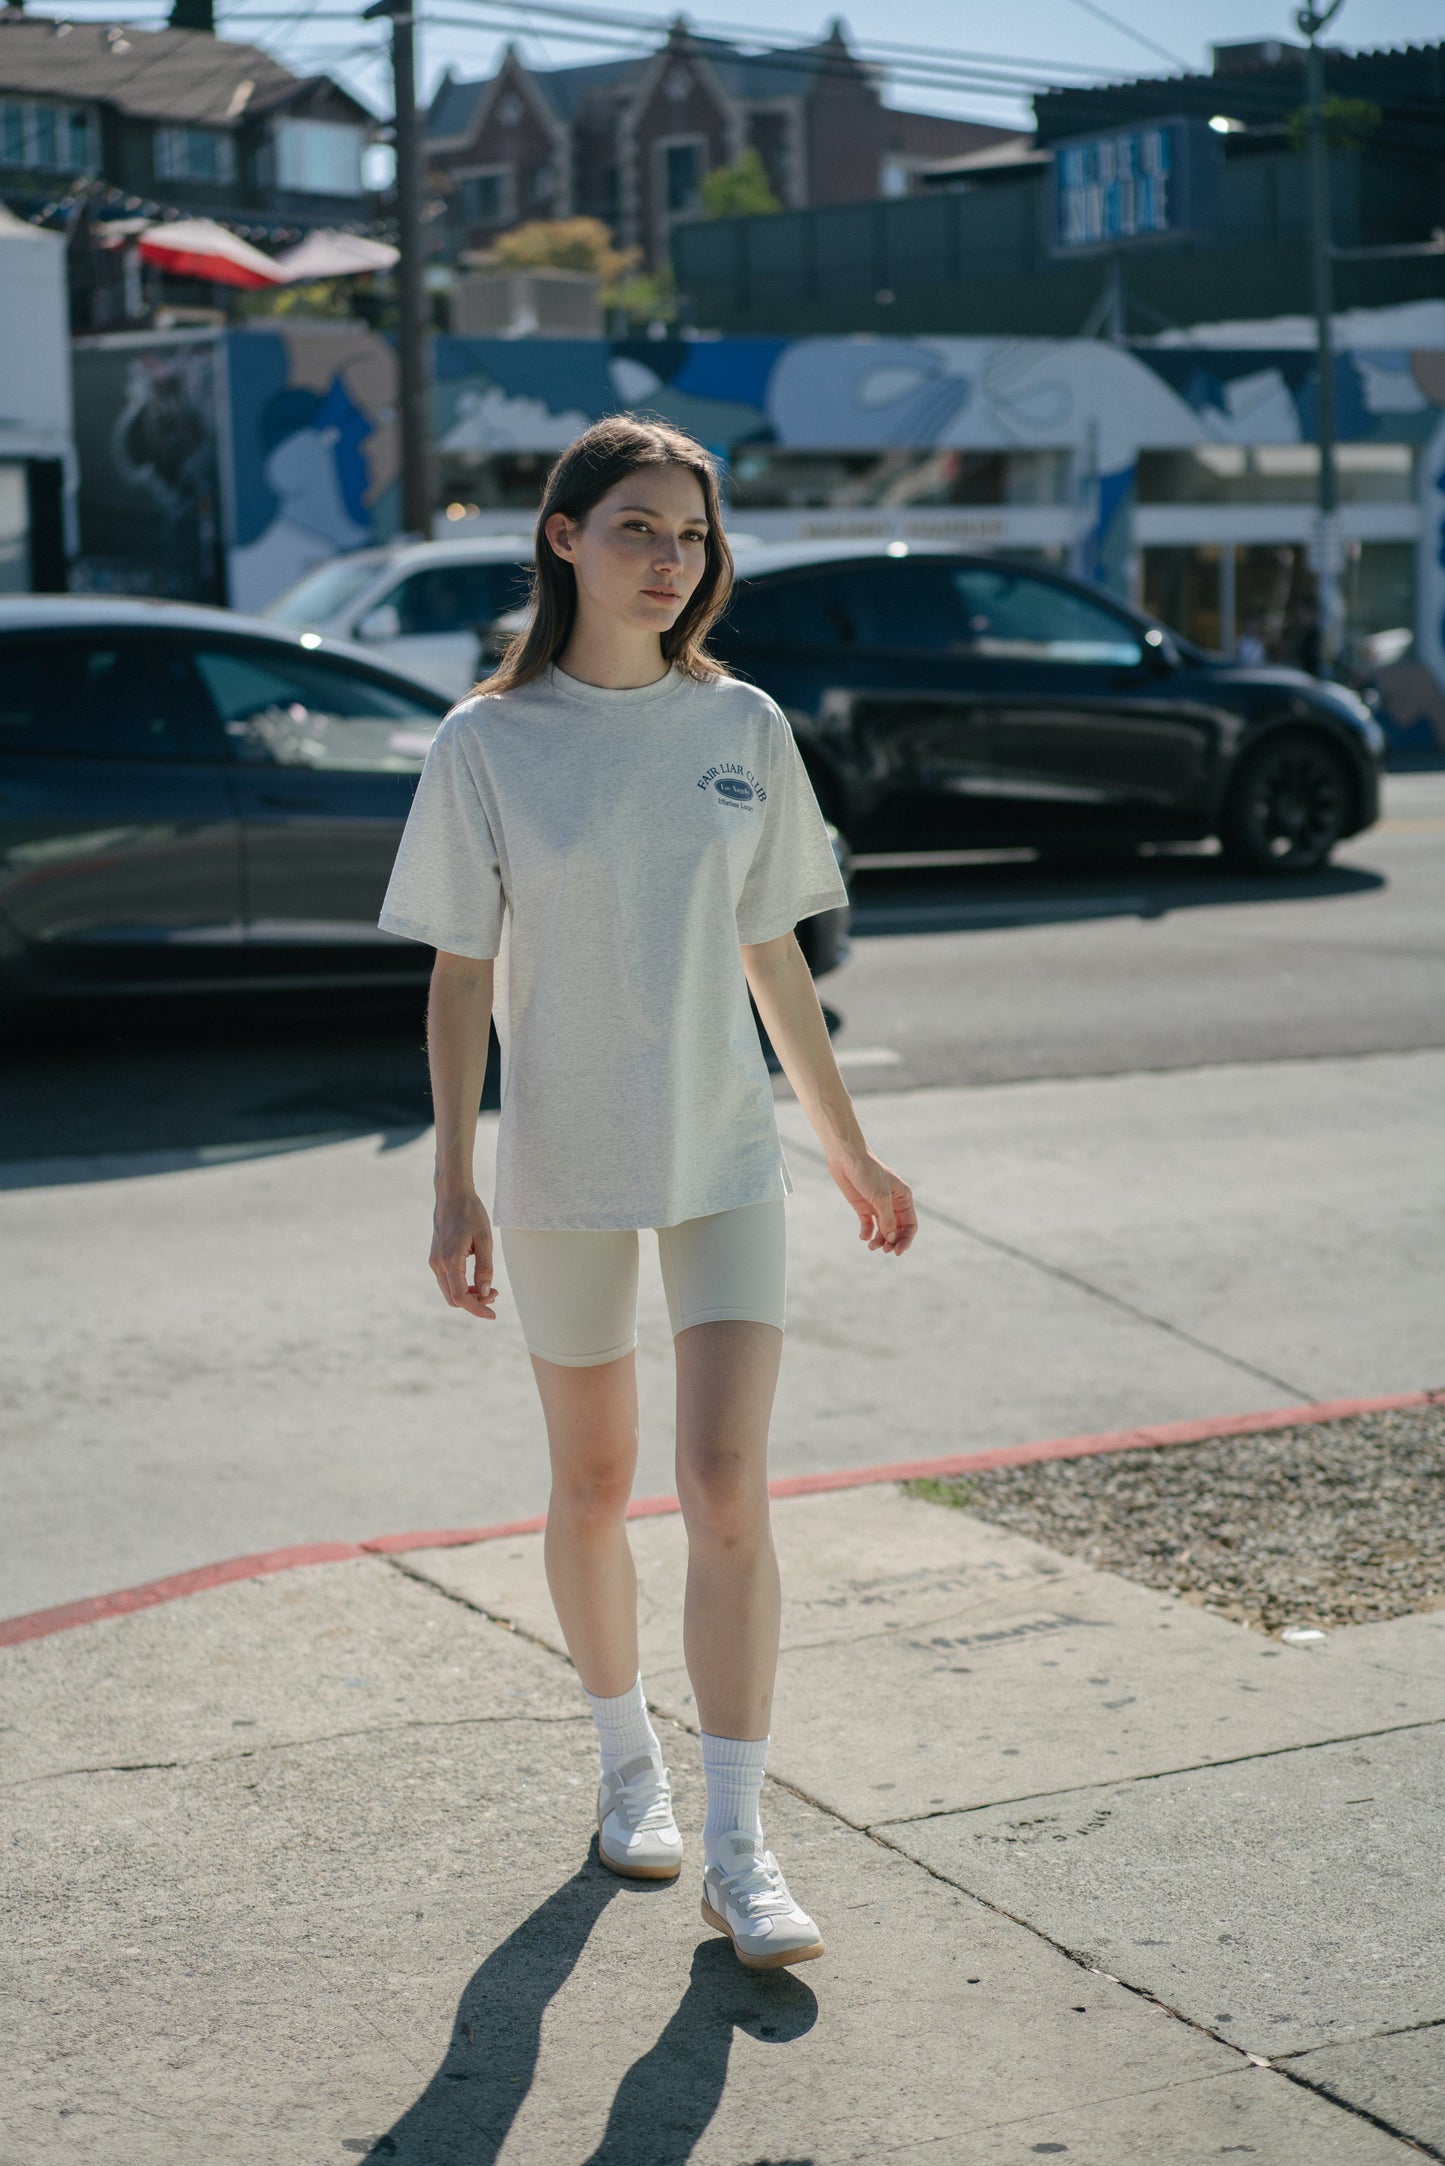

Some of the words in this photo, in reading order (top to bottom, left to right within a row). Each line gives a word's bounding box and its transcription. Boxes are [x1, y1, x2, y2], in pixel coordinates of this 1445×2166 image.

[697, 767, 720, 790] FAIR
[719, 763, 744, 776] LIAR
[746, 770, 767, 802] CLUB
